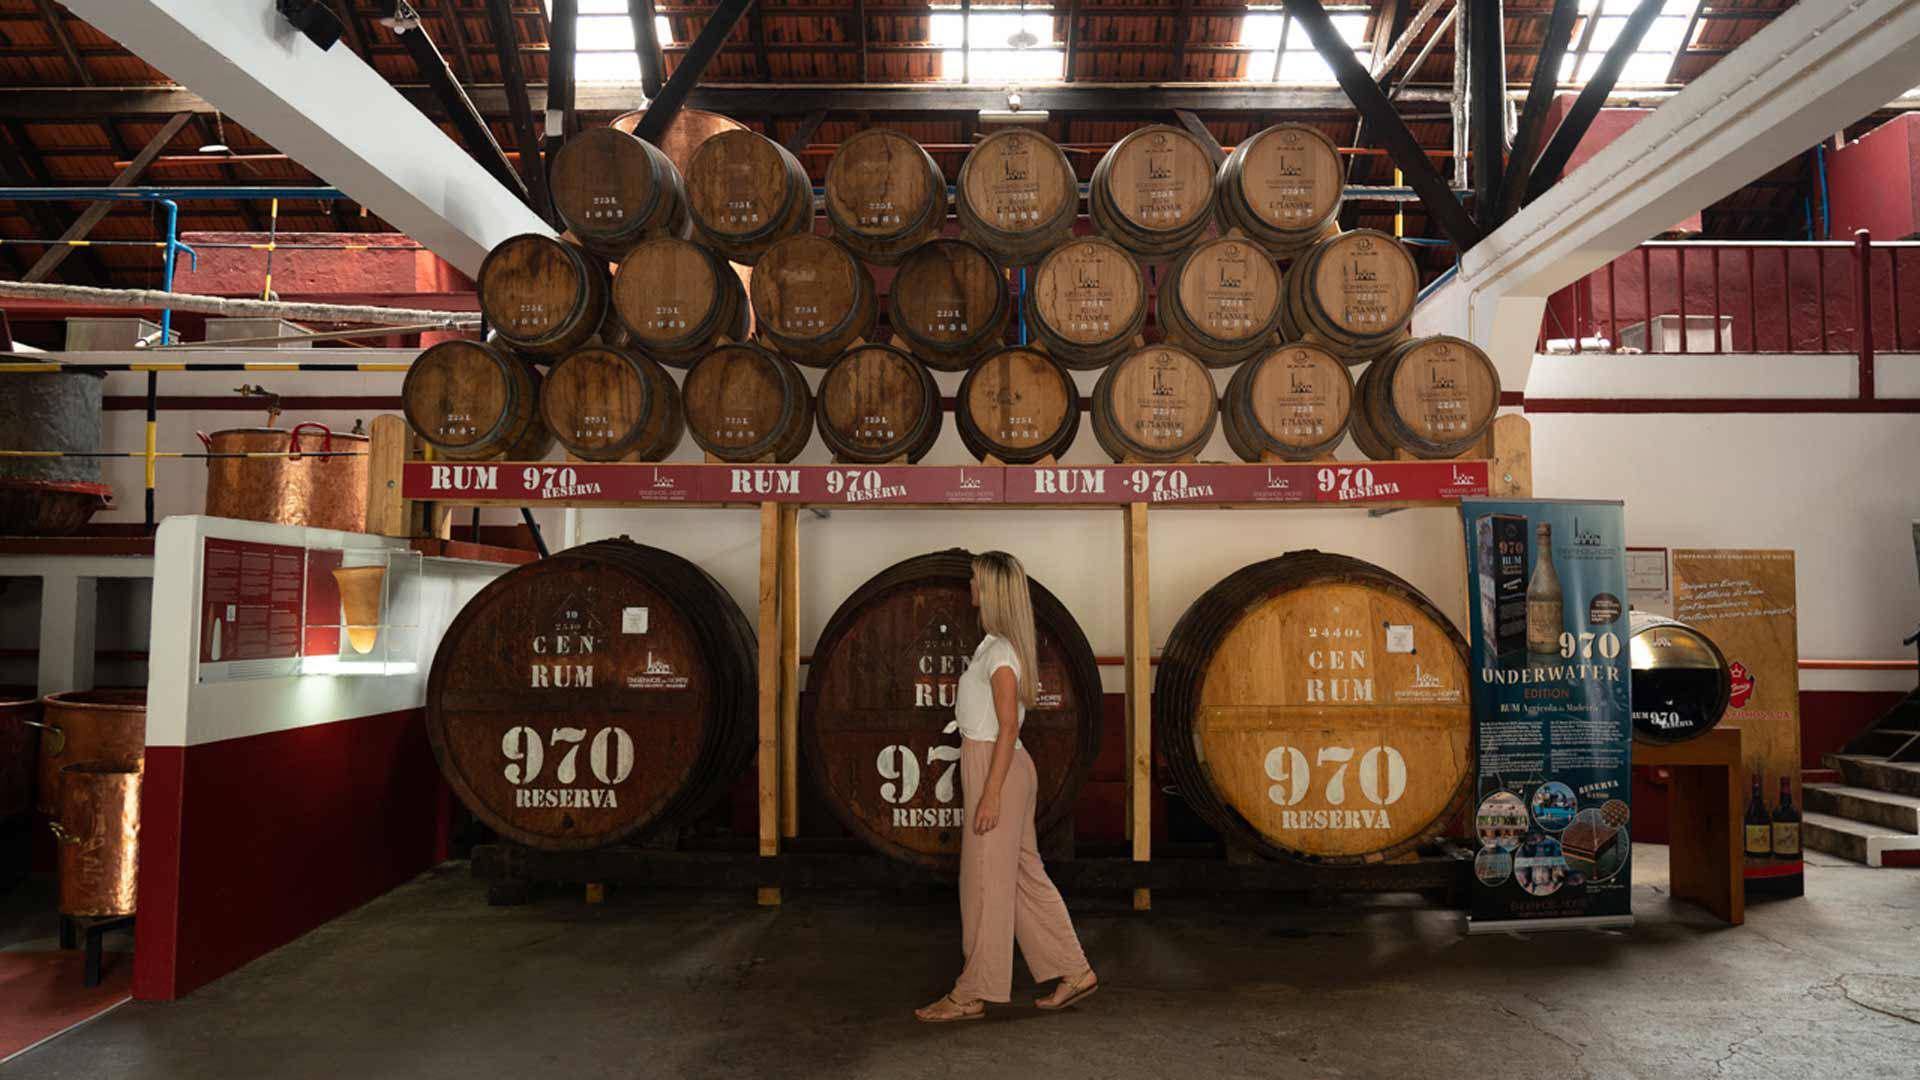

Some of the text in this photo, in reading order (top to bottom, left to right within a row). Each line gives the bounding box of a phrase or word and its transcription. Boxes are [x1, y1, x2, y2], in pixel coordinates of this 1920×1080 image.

[430, 466, 577, 490] RUM 970
[730, 469, 882, 493] RUM 970
[1034, 470, 1188, 493] RUM 970
[1317, 468, 1375, 492] 970
[542, 482, 601, 499] RESERVA
[846, 485, 907, 502] RESERVA
[1153, 485, 1214, 502] RESERVA
[1338, 482, 1400, 500] RESERVA
[1499, 541, 1524, 555] 970
[533, 635, 594, 654] CEN
[1559, 632, 1620, 658] 970
[1309, 650, 1367, 669] CEN
[531, 665, 594, 688] RUM
[1482, 664, 1620, 686] UNDERWATER
[915, 684, 958, 707] RU
[1306, 678, 1374, 702] RUM
[1524, 688, 1568, 699] EDITION
[1650, 711, 1680, 725] 970
[502, 726, 635, 785] 970
[876, 745, 961, 804] 97
[1264, 746, 1407, 806] 970
[515, 789, 618, 808] RESERVA
[1281, 809, 1391, 829] RESERVA
